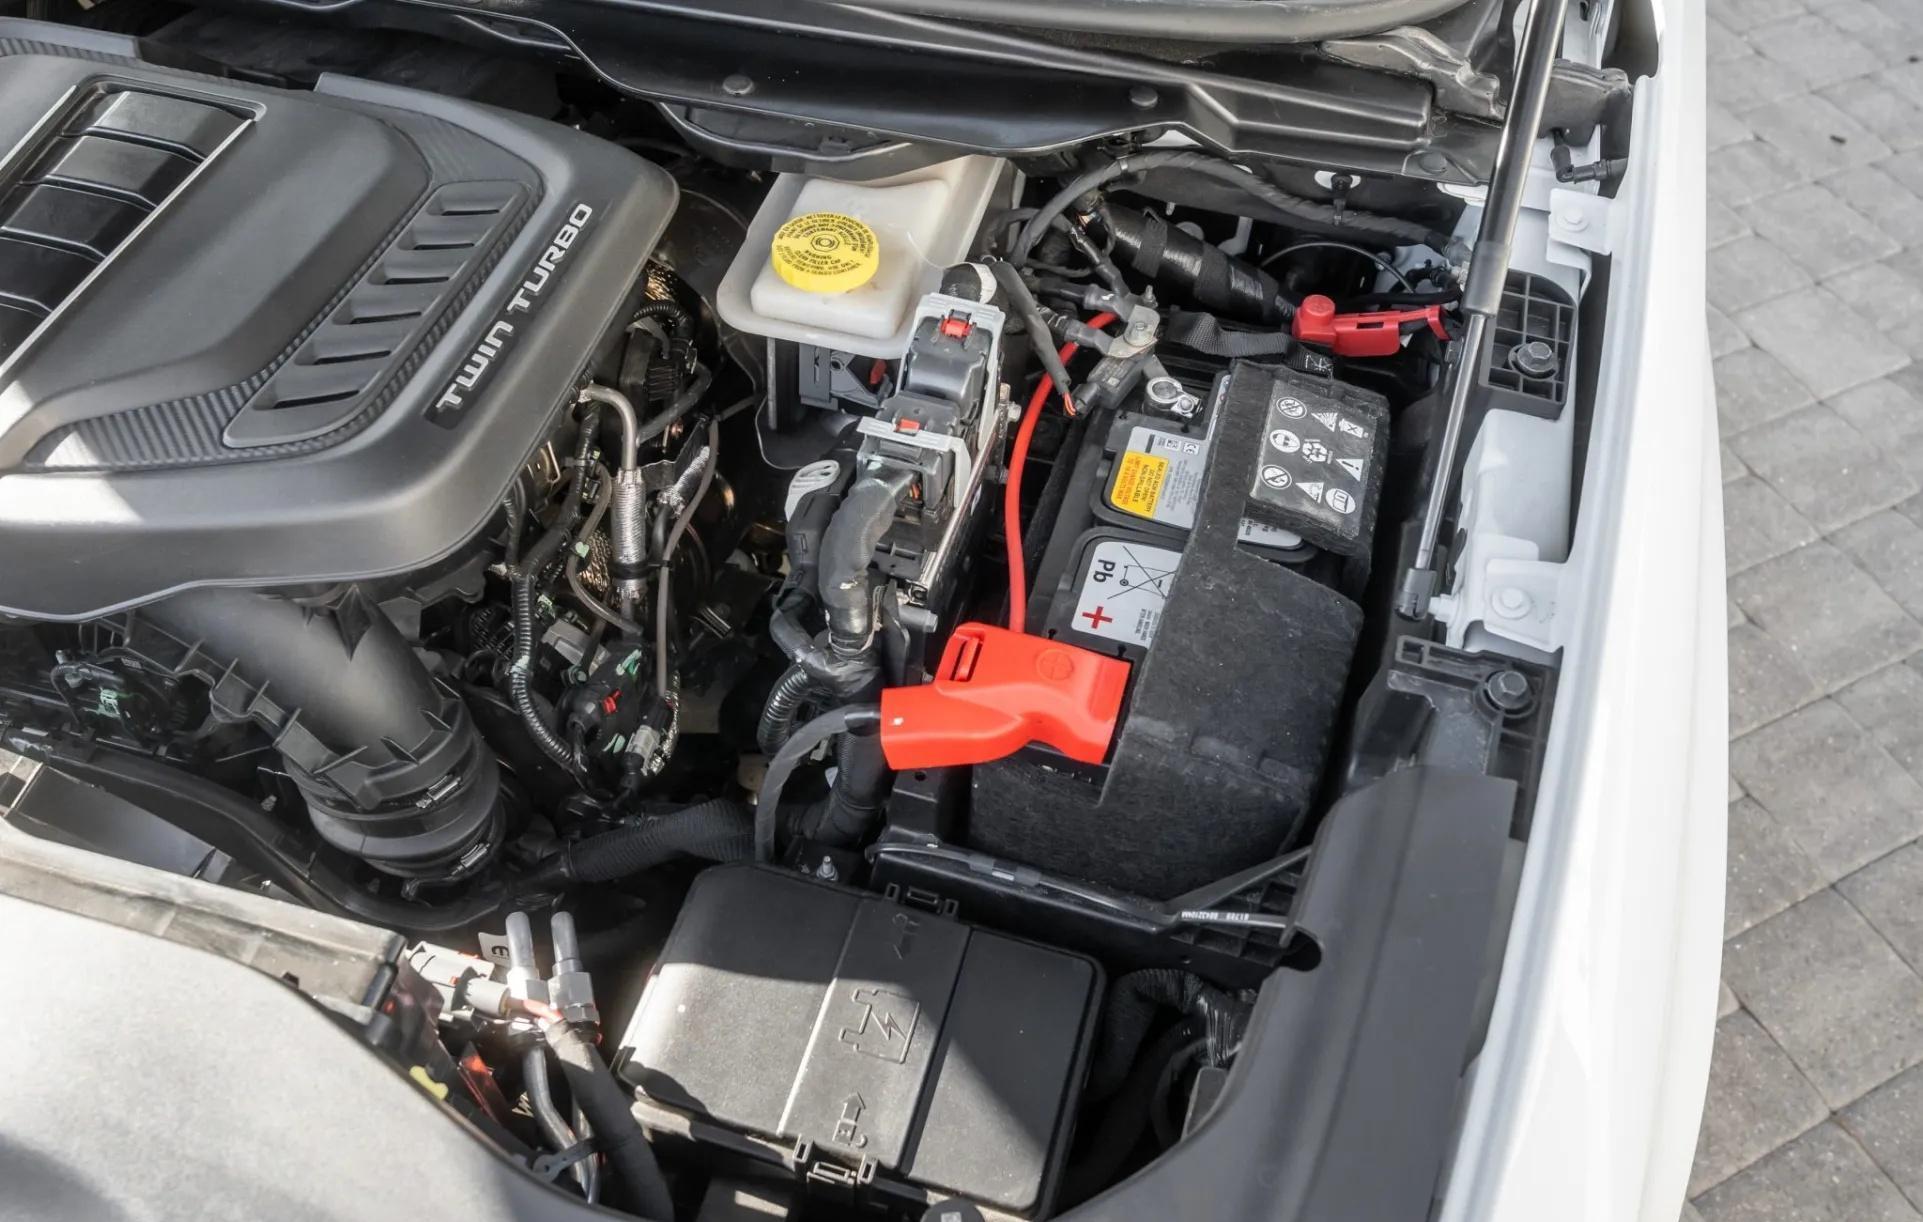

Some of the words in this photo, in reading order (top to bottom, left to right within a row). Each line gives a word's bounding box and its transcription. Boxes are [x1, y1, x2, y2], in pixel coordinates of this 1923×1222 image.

[436, 320, 514, 410] TWIN
[506, 203, 593, 313] TURBO
[1093, 559, 1116, 583] Pb
